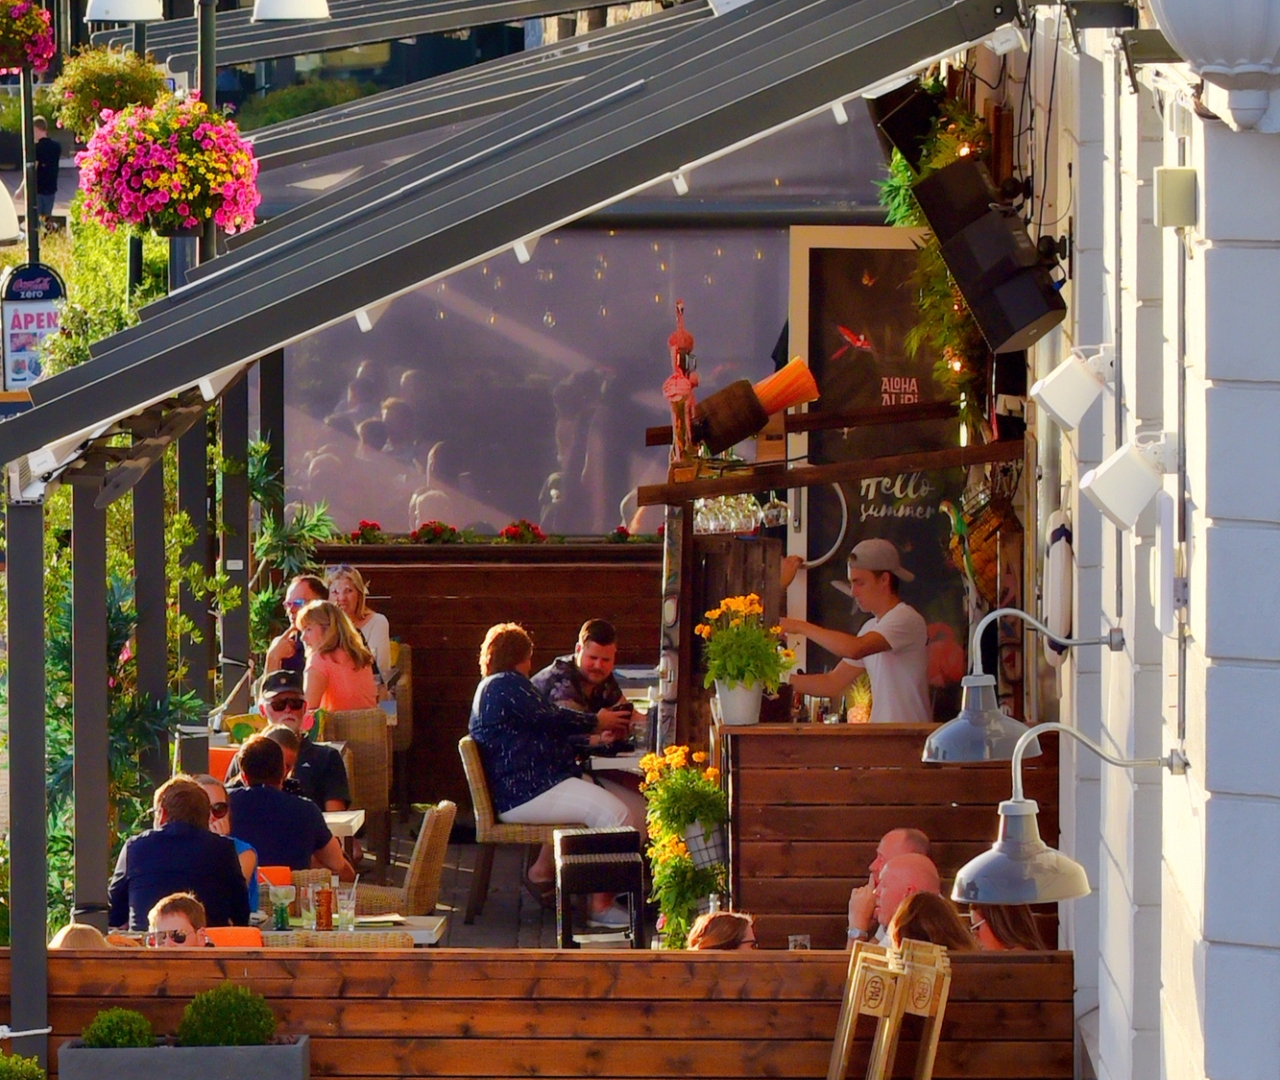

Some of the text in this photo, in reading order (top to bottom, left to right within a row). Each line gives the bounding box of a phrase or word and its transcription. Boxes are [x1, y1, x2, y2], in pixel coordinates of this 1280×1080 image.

[20, 290, 44, 299] zero
[10, 309, 58, 330] ÅPEN
[881, 376, 919, 393] ALOHA
[860, 503, 935, 523] summer
